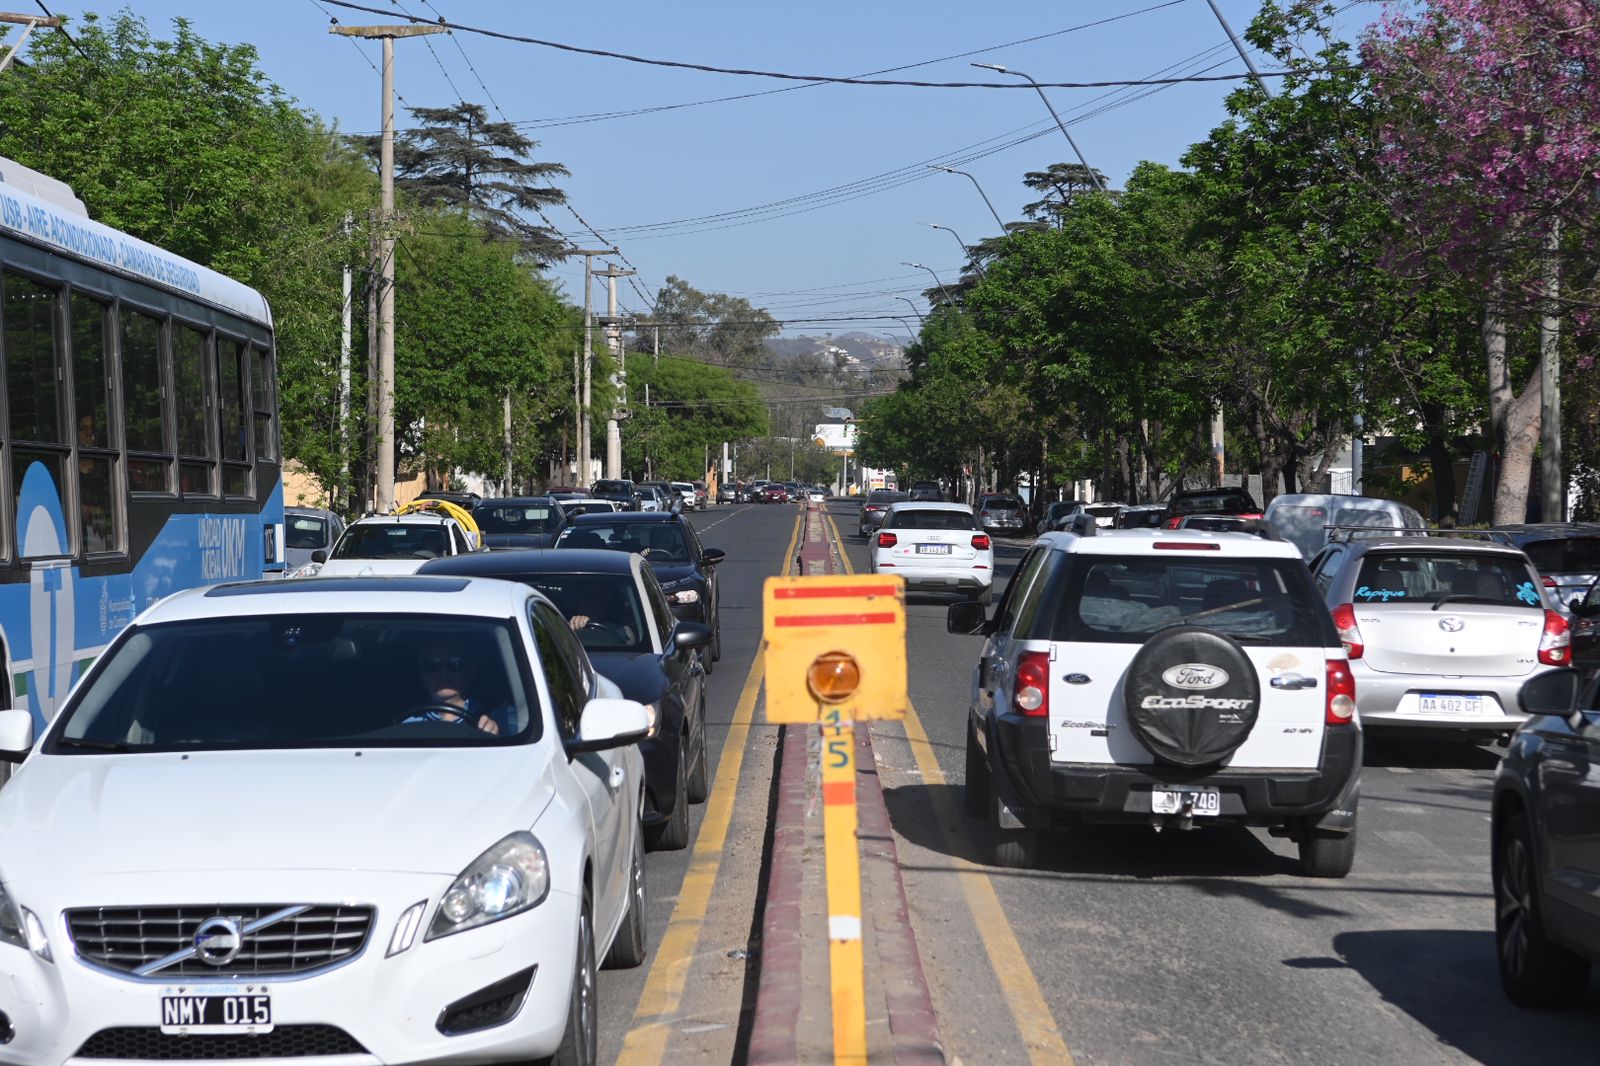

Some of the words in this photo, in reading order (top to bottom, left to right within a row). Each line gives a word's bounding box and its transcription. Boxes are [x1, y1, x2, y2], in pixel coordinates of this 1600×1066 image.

[27, 203, 49, 238] AIRE
[50, 213, 117, 265] ACONDICIONADO
[1355, 585, 1406, 601] Repique
[1176, 666, 1215, 688] Ford
[1423, 699, 1437, 710] AA
[1440, 699, 1461, 711] 402
[1190, 792, 1216, 809] 748
[164, 997, 208, 1025] NMY
[223, 997, 269, 1024] 015
